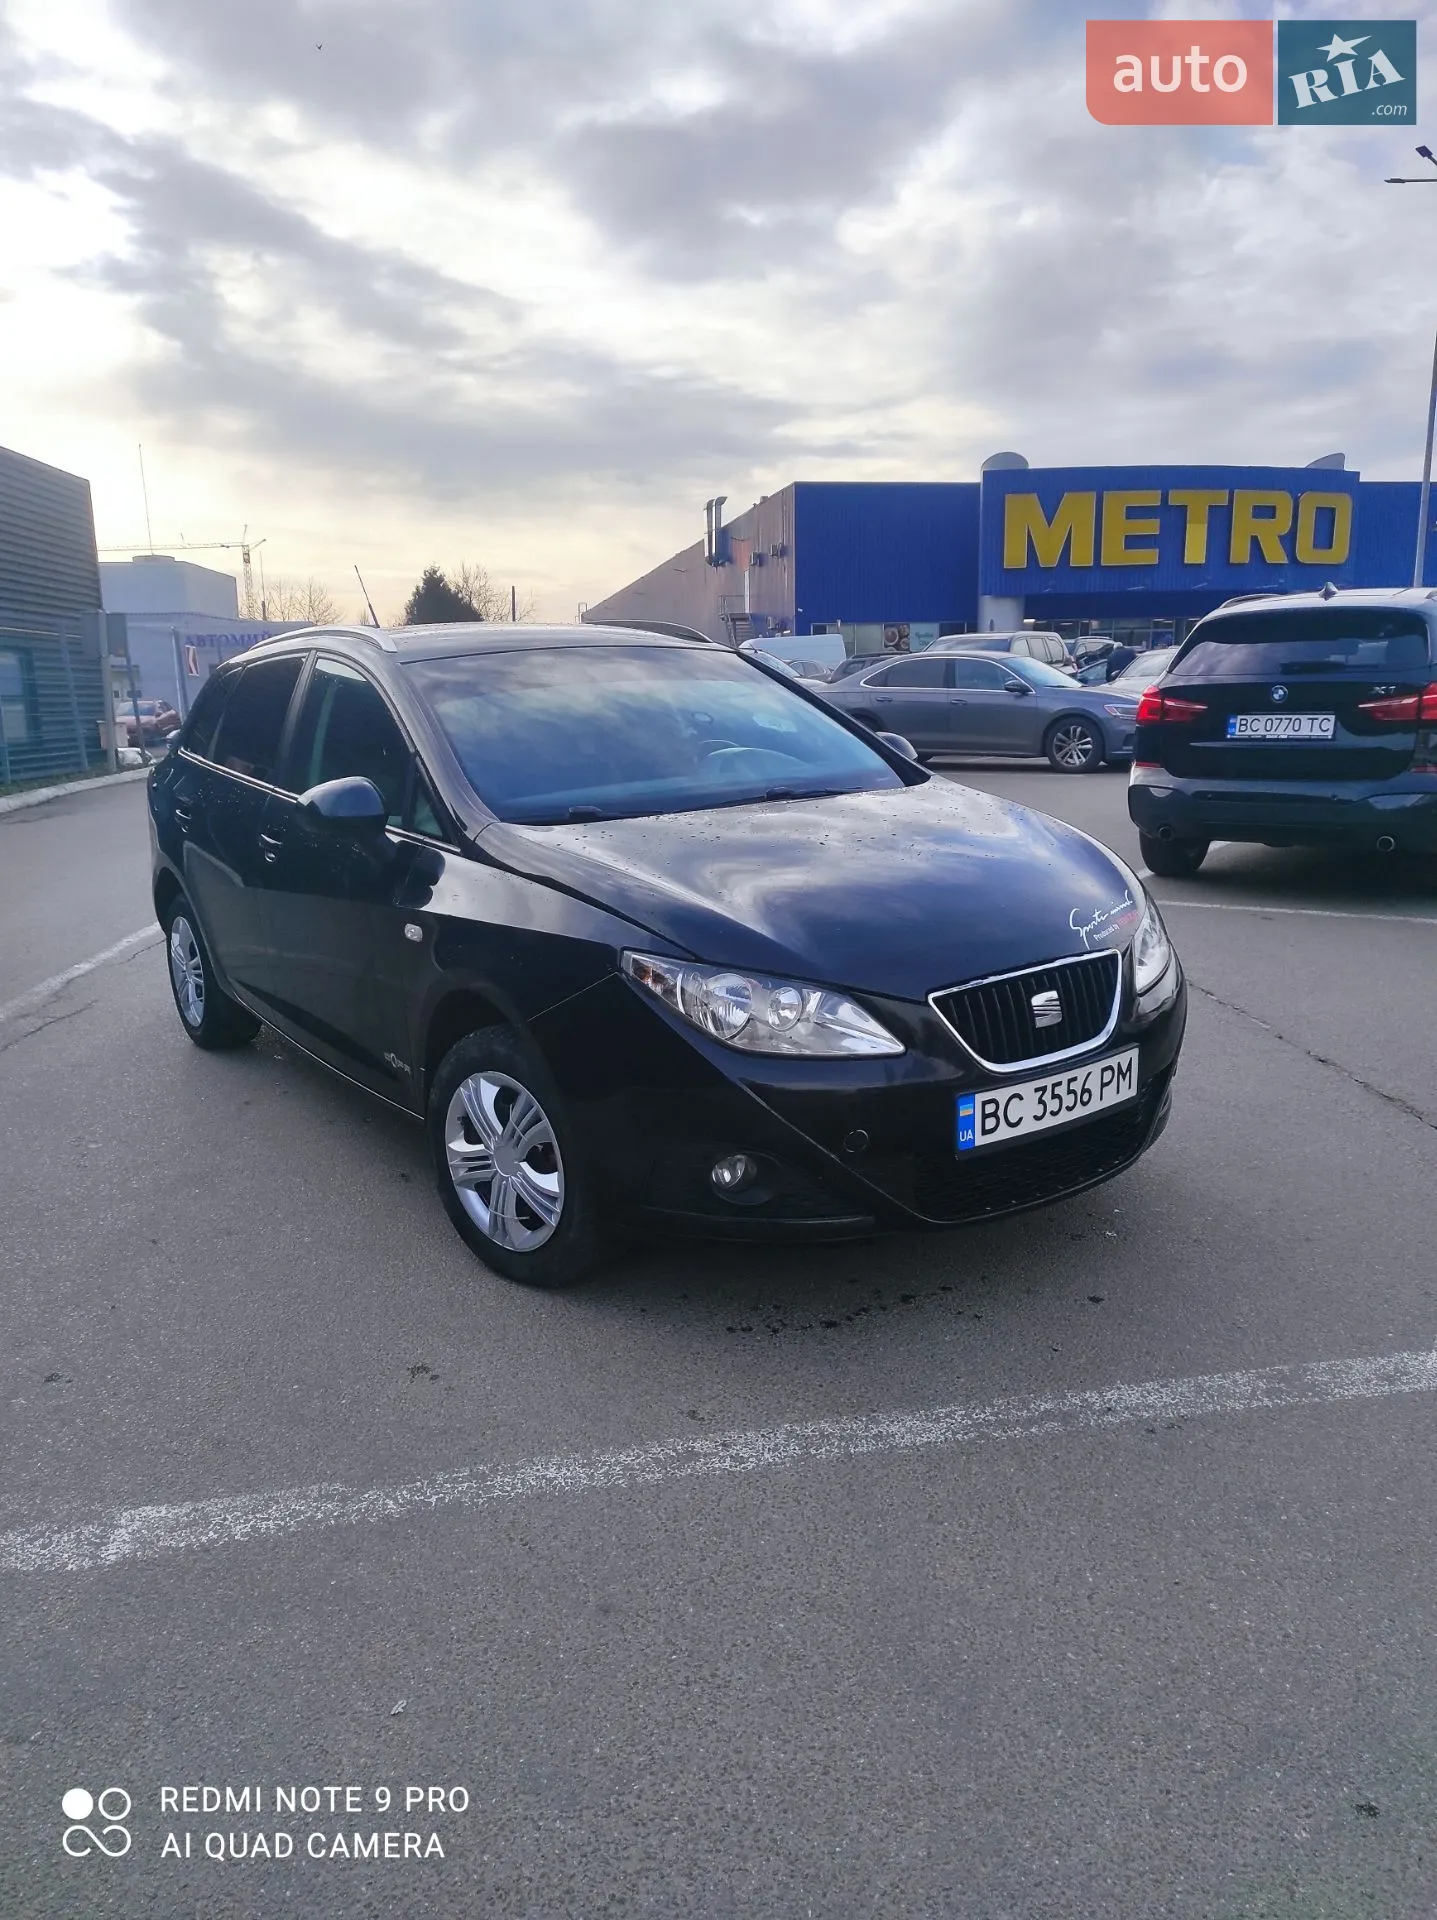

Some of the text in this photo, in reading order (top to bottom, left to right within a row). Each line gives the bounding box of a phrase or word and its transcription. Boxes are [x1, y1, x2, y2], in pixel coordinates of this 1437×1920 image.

[1003, 489, 1353, 569] METRO
[1238, 718, 1261, 732] BC
[1264, 717, 1302, 732] 0770
[1306, 717, 1331, 732] TC
[981, 1056, 1133, 1136] BC 3556 PM
[959, 1129, 974, 1142] UA
